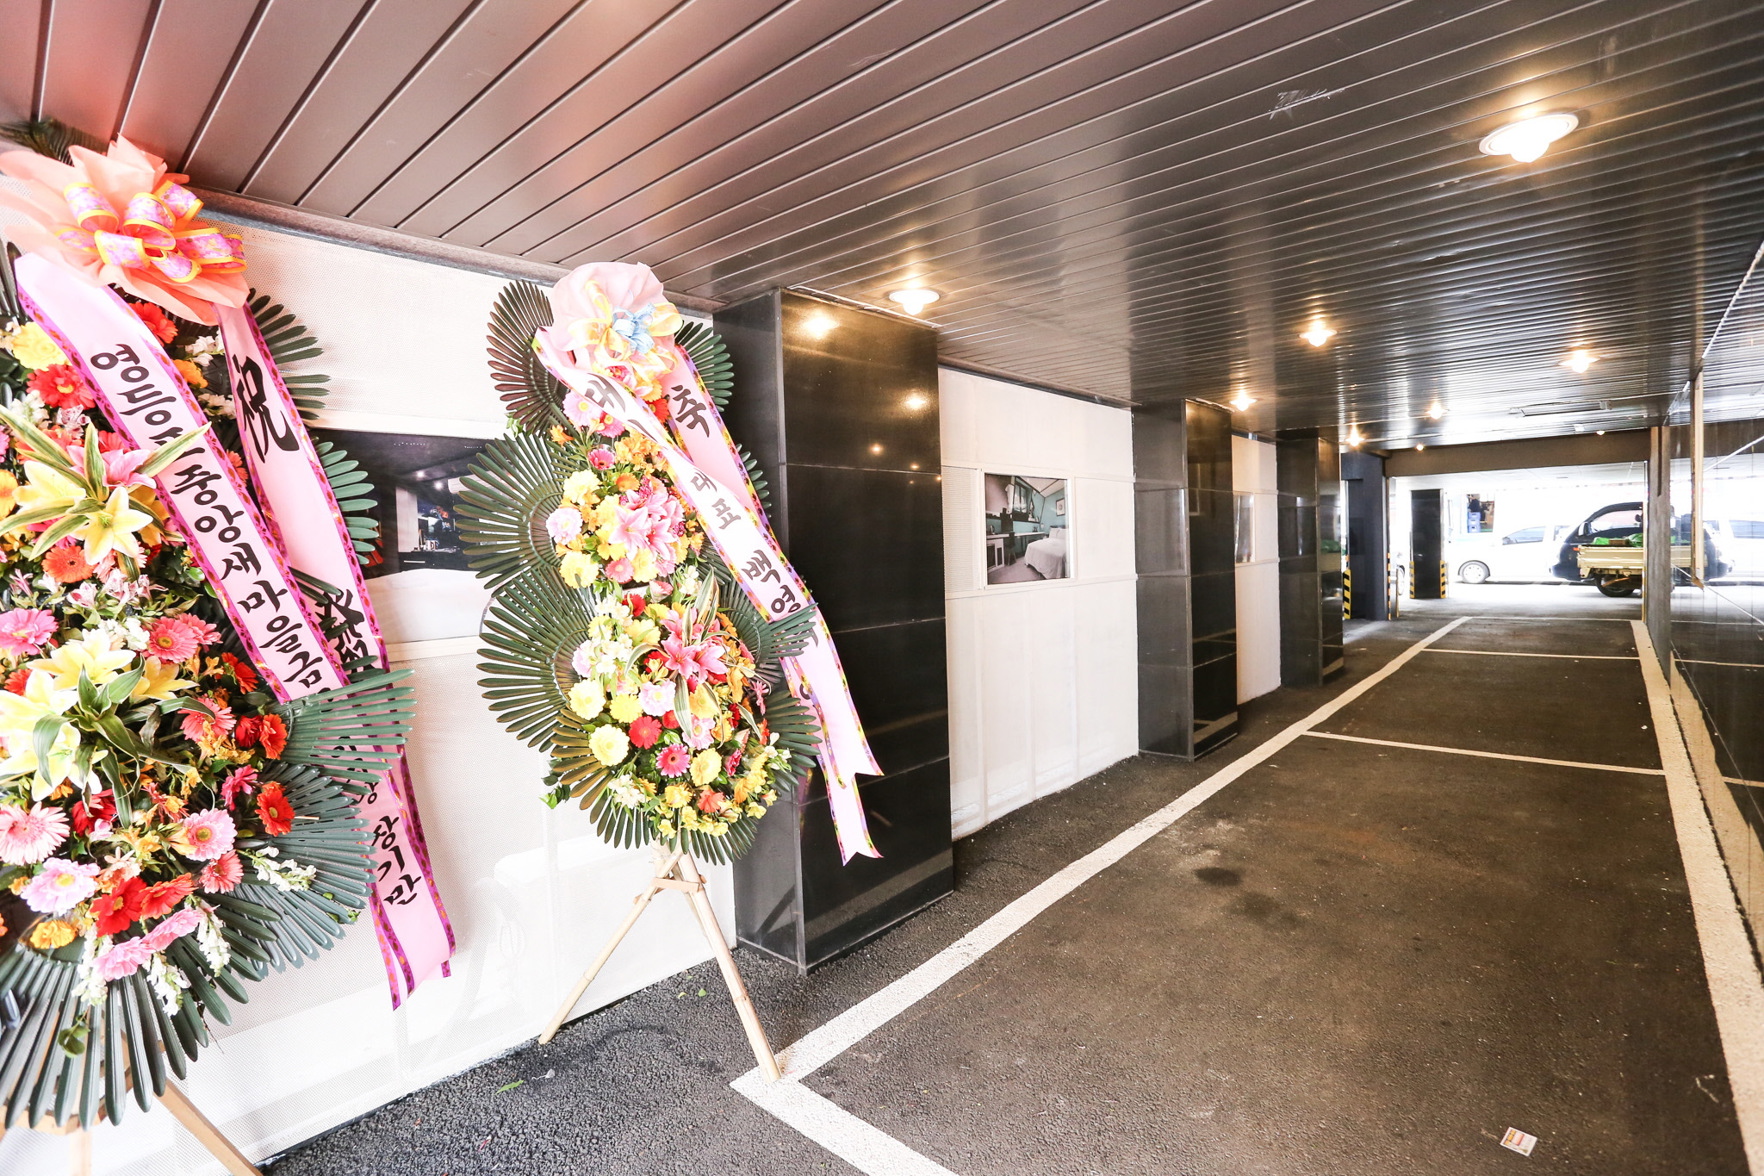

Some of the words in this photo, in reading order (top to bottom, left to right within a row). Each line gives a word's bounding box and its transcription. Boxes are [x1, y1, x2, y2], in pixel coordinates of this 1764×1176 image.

[232, 353, 300, 464] 祝
[671, 384, 710, 438] 축
[690, 467, 741, 530] 대표
